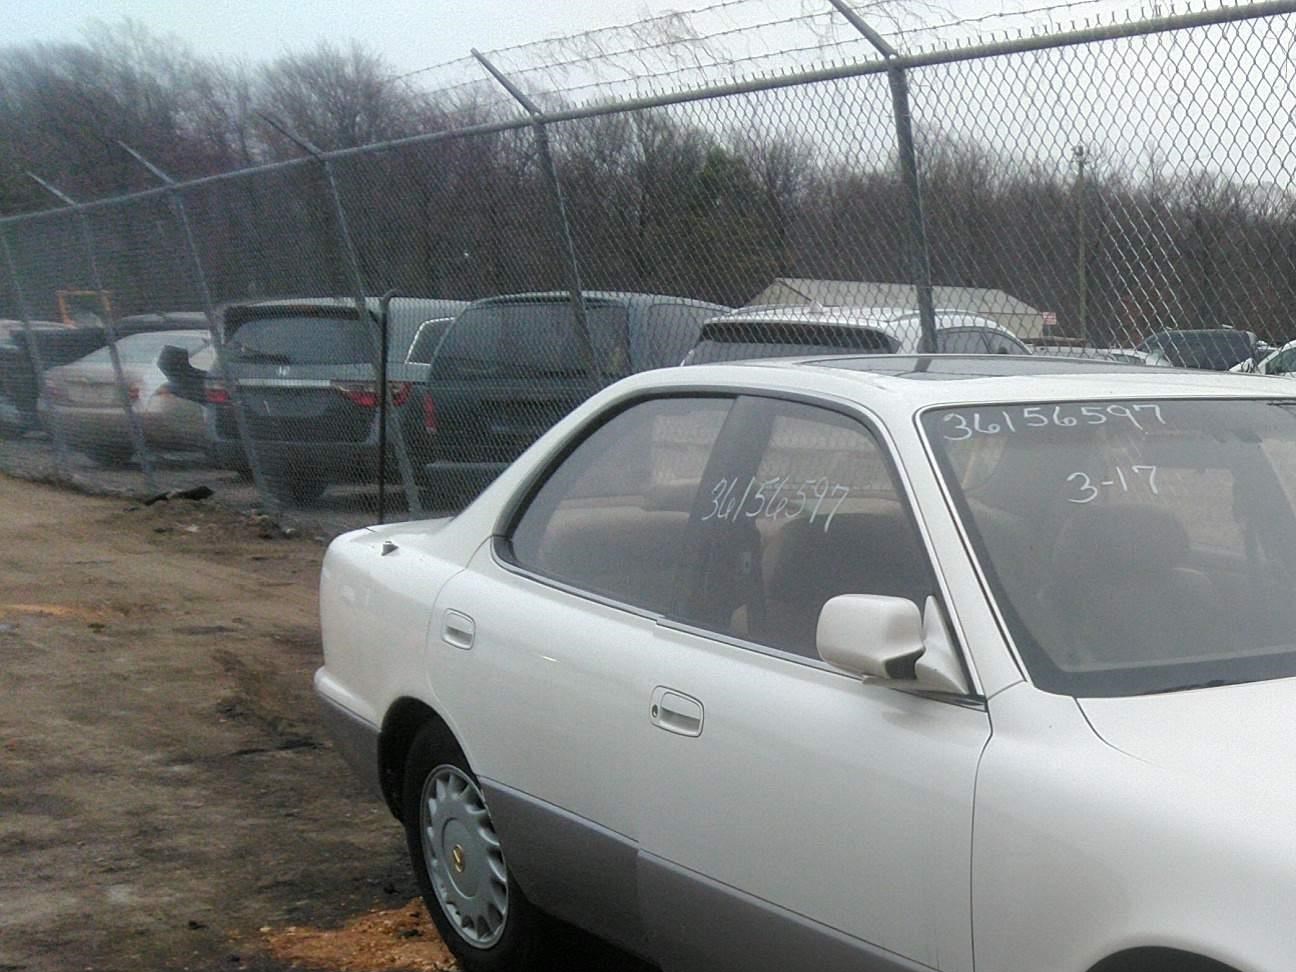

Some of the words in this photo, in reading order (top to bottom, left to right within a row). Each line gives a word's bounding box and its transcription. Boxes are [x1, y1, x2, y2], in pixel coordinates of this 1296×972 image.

[944, 405, 1166, 440] 36156597
[1066, 465, 1158, 503] 3-17
[702, 476, 849, 532] 36156597
